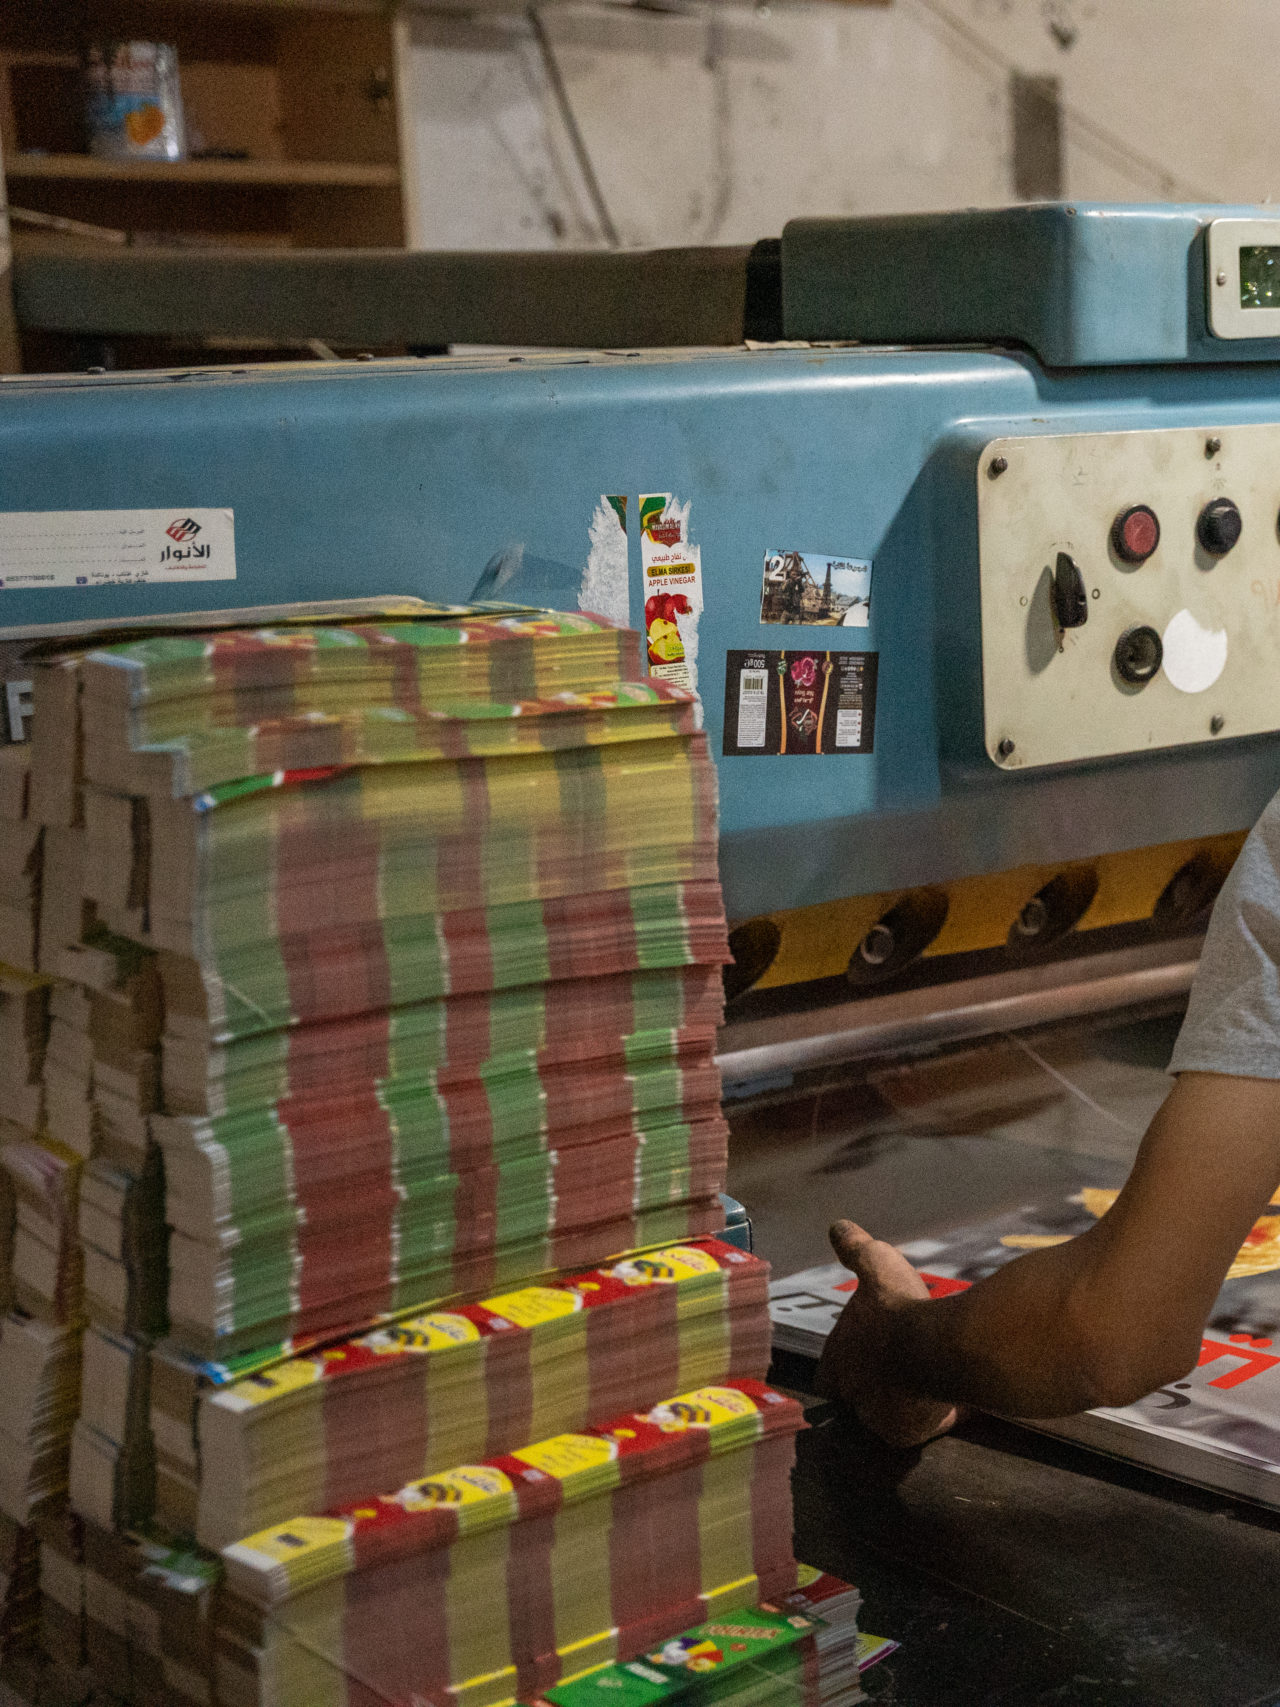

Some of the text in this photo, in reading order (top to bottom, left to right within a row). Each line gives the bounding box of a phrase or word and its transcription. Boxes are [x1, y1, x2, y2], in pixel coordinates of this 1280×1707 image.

[160, 541, 210, 563] الأنوار
[651, 567, 668, 577] ELMA
[649, 576, 696, 587] APPLE VINEGAR
